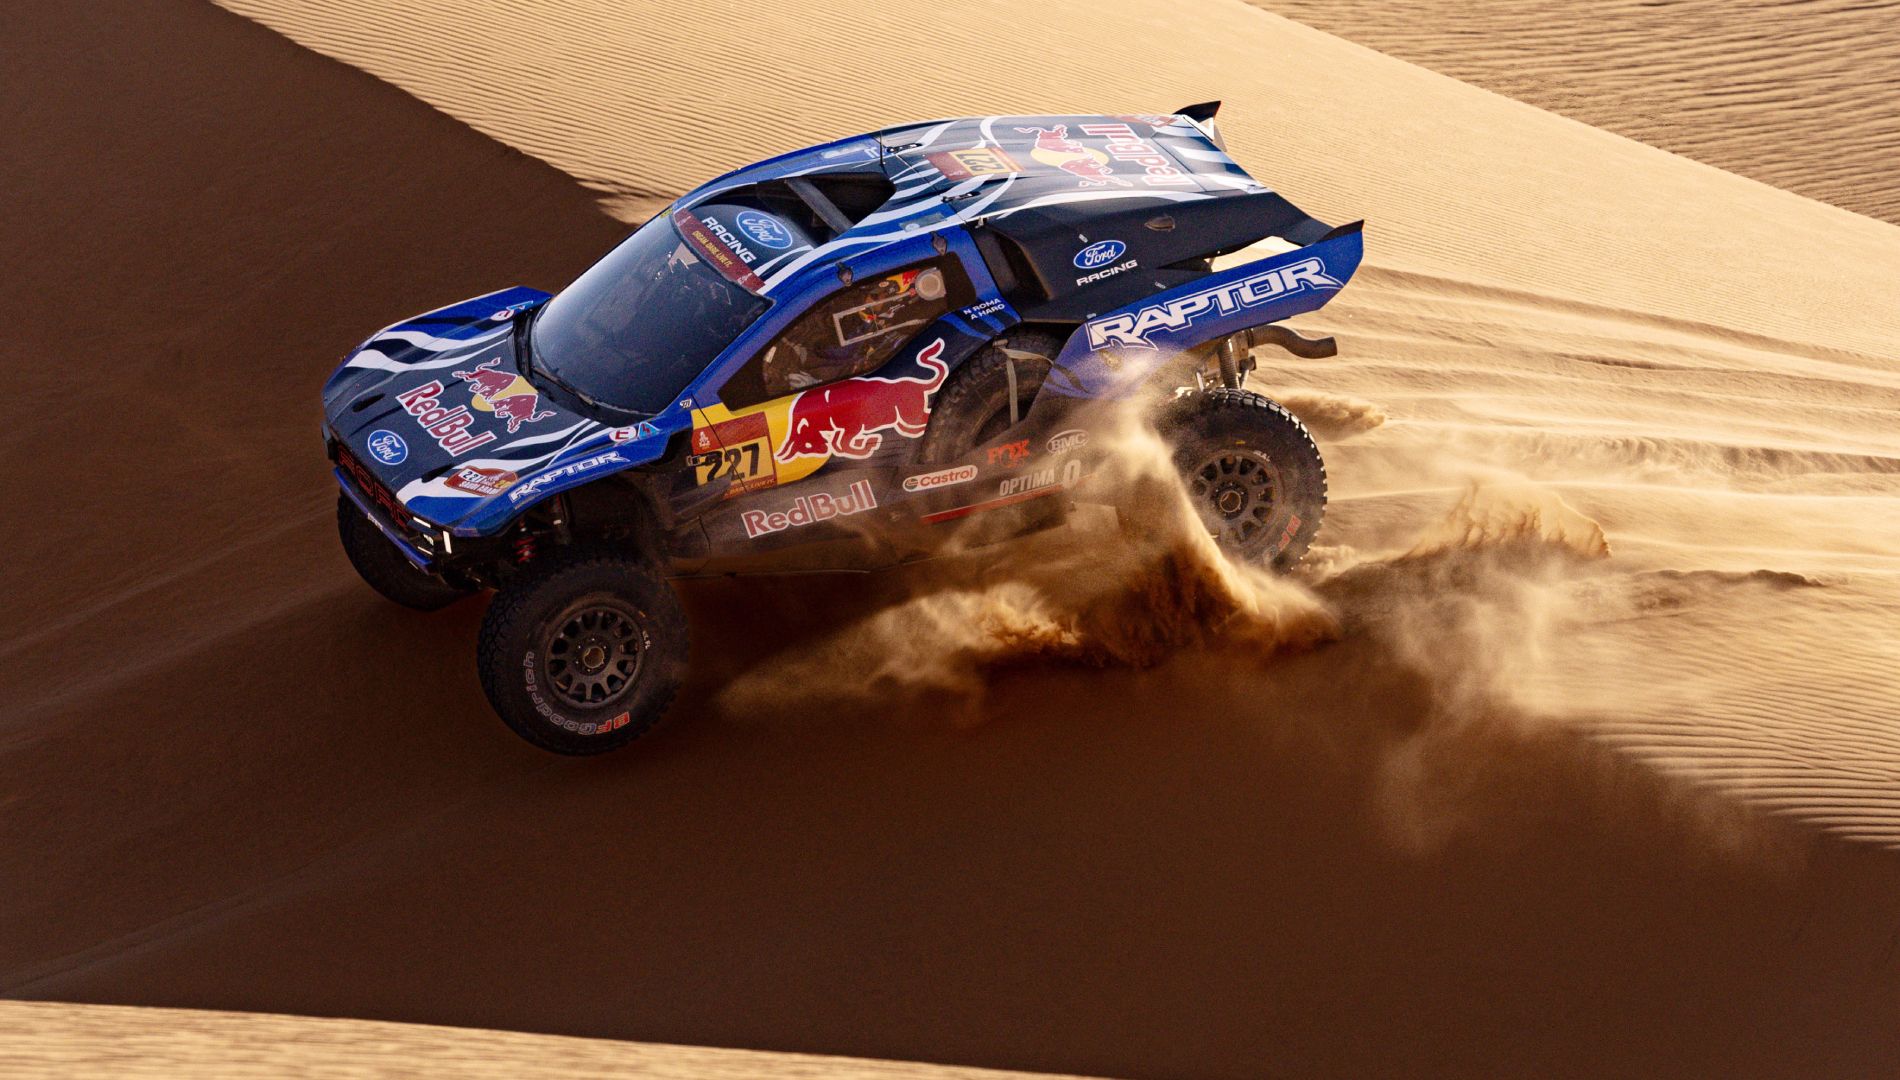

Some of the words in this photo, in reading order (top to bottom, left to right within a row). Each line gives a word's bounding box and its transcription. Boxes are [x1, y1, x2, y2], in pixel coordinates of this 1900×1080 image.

[955, 153, 1004, 172] 227
[701, 216, 757, 264] RACING
[742, 218, 783, 242] Ford
[1084, 244, 1117, 266] Ford
[1076, 259, 1138, 286] RACING
[971, 312, 979, 320] A
[979, 304, 1005, 317] HARO
[972, 298, 1000, 311] ROMA
[1086, 257, 1346, 351] RAPTOR
[396, 379, 468, 428] Red
[372, 435, 401, 460] Ford
[427, 411, 497, 457] Bull
[1050, 433, 1086, 451] BMC
[703, 442, 759, 481] 227
[987, 440, 1030, 465] FOX
[508, 451, 631, 503] RAPTOR
[919, 466, 974, 488] Castrol
[999, 468, 1055, 496] OPTIMA
[741, 498, 811, 538] Red
[808, 480, 877, 519] Bull
[522, 651, 631, 735] BFGoodrich
